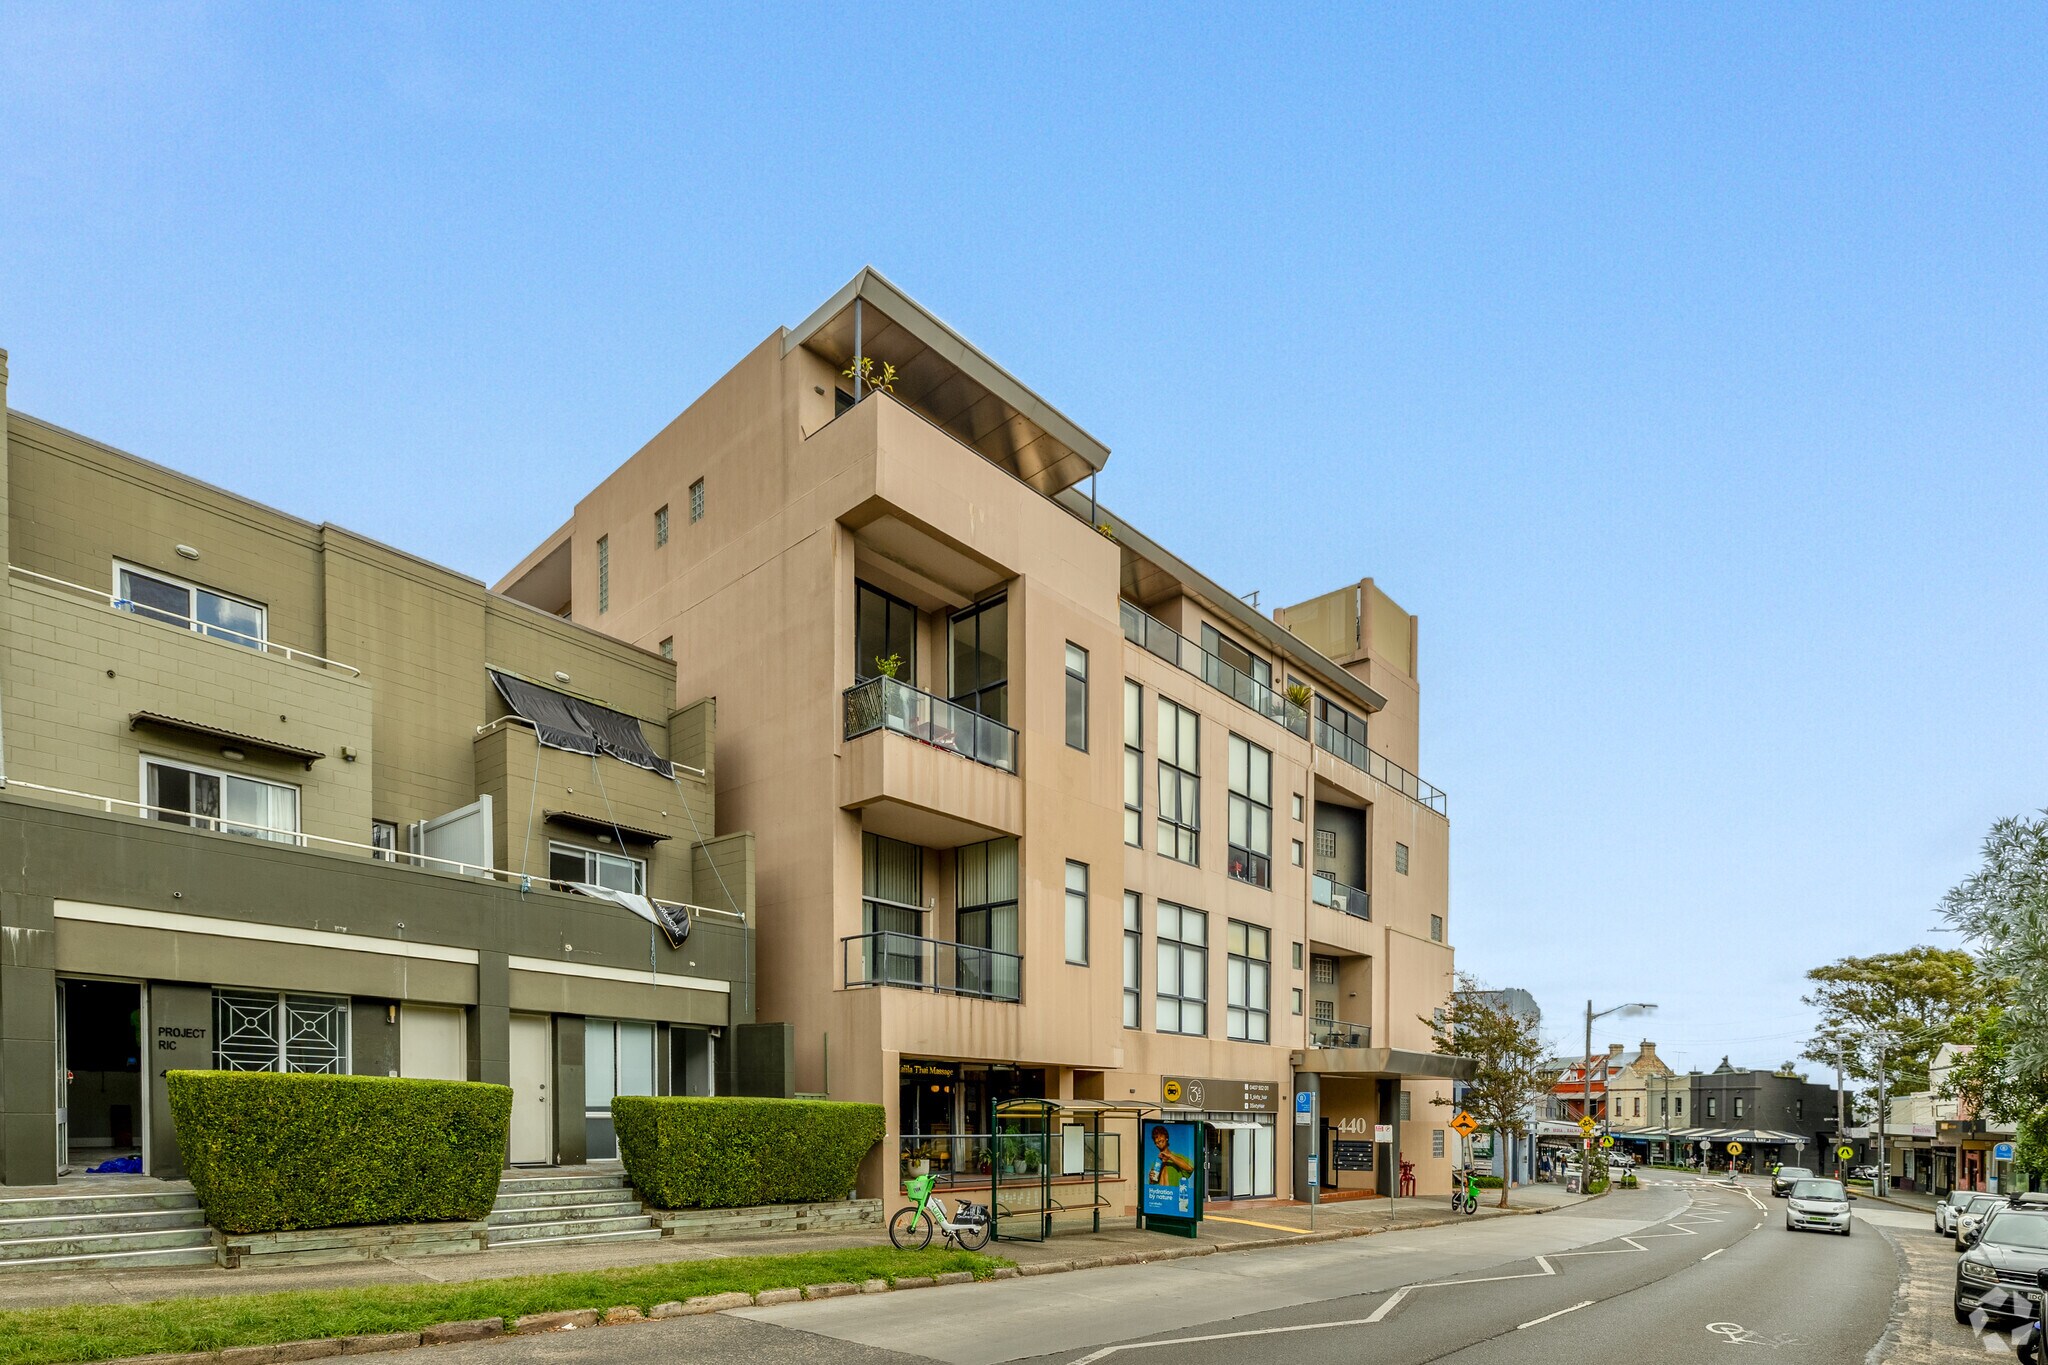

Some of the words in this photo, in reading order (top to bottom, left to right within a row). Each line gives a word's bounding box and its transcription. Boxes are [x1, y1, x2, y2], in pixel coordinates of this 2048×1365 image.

[158, 1026, 207, 1039] PROJECT
[158, 1040, 177, 1051] RIC
[913, 1065, 929, 1074] Thai
[929, 1066, 954, 1078] Massage
[1189, 1086, 1198, 1103] 3
[1337, 1117, 1367, 1134] 440
[1148, 1187, 1174, 1196] Hydration
